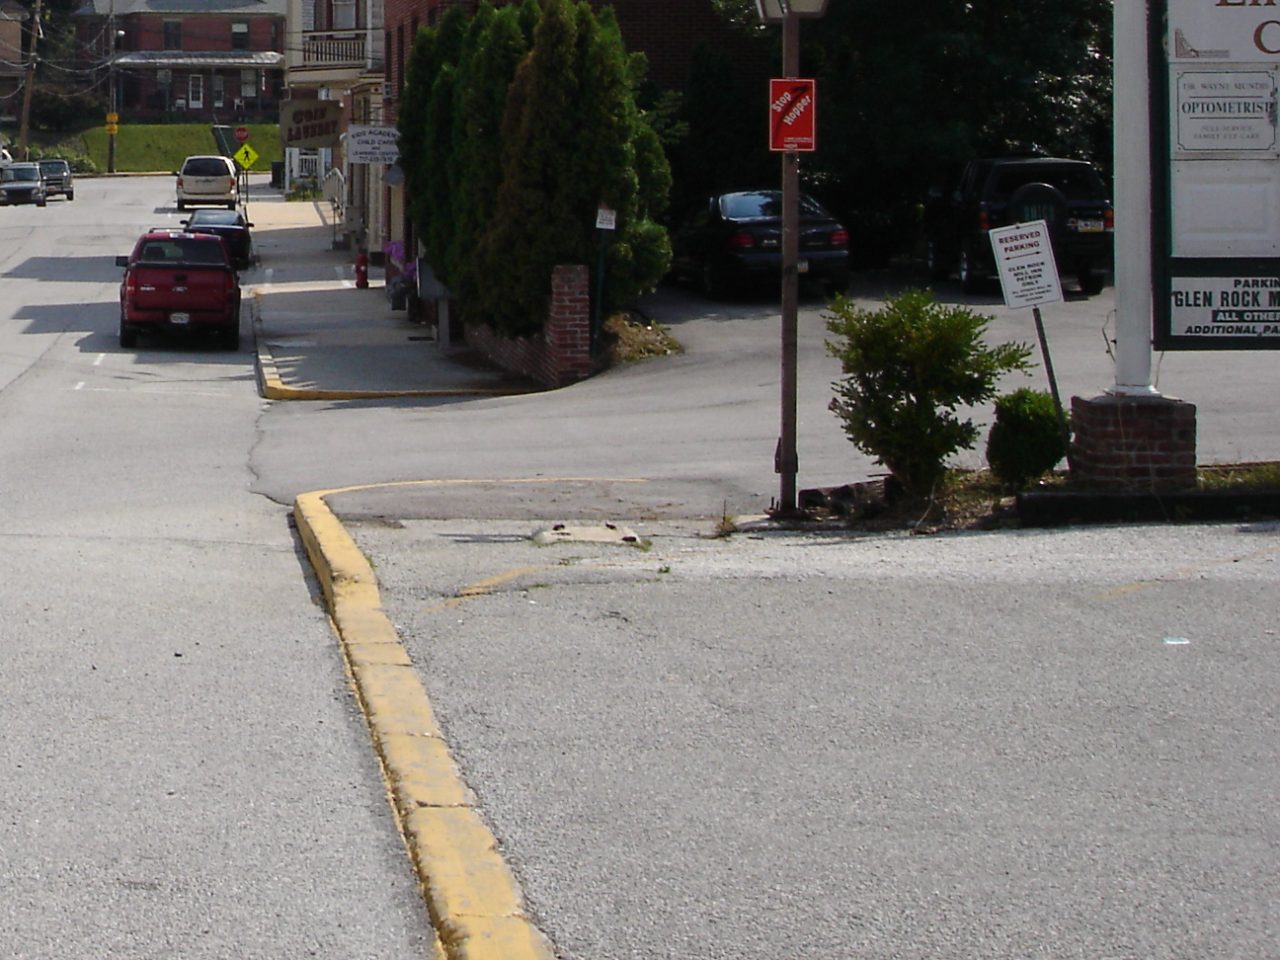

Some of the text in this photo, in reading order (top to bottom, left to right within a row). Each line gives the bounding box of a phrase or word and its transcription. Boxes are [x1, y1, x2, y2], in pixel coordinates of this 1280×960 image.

[771, 92, 791, 112] Stop
[1181, 102, 1274, 114] OPTOMETRIST
[783, 95, 811, 125] Hopper
[999, 231, 1040, 244] RESERVED
[1004, 241, 1040, 253] PARKING
[1174, 291, 1212, 307] GLEN
[1220, 291, 1260, 307] ROCK
[1216, 312, 1239, 321] ALL
[1184, 325, 1257, 334] ADDITIONAL
